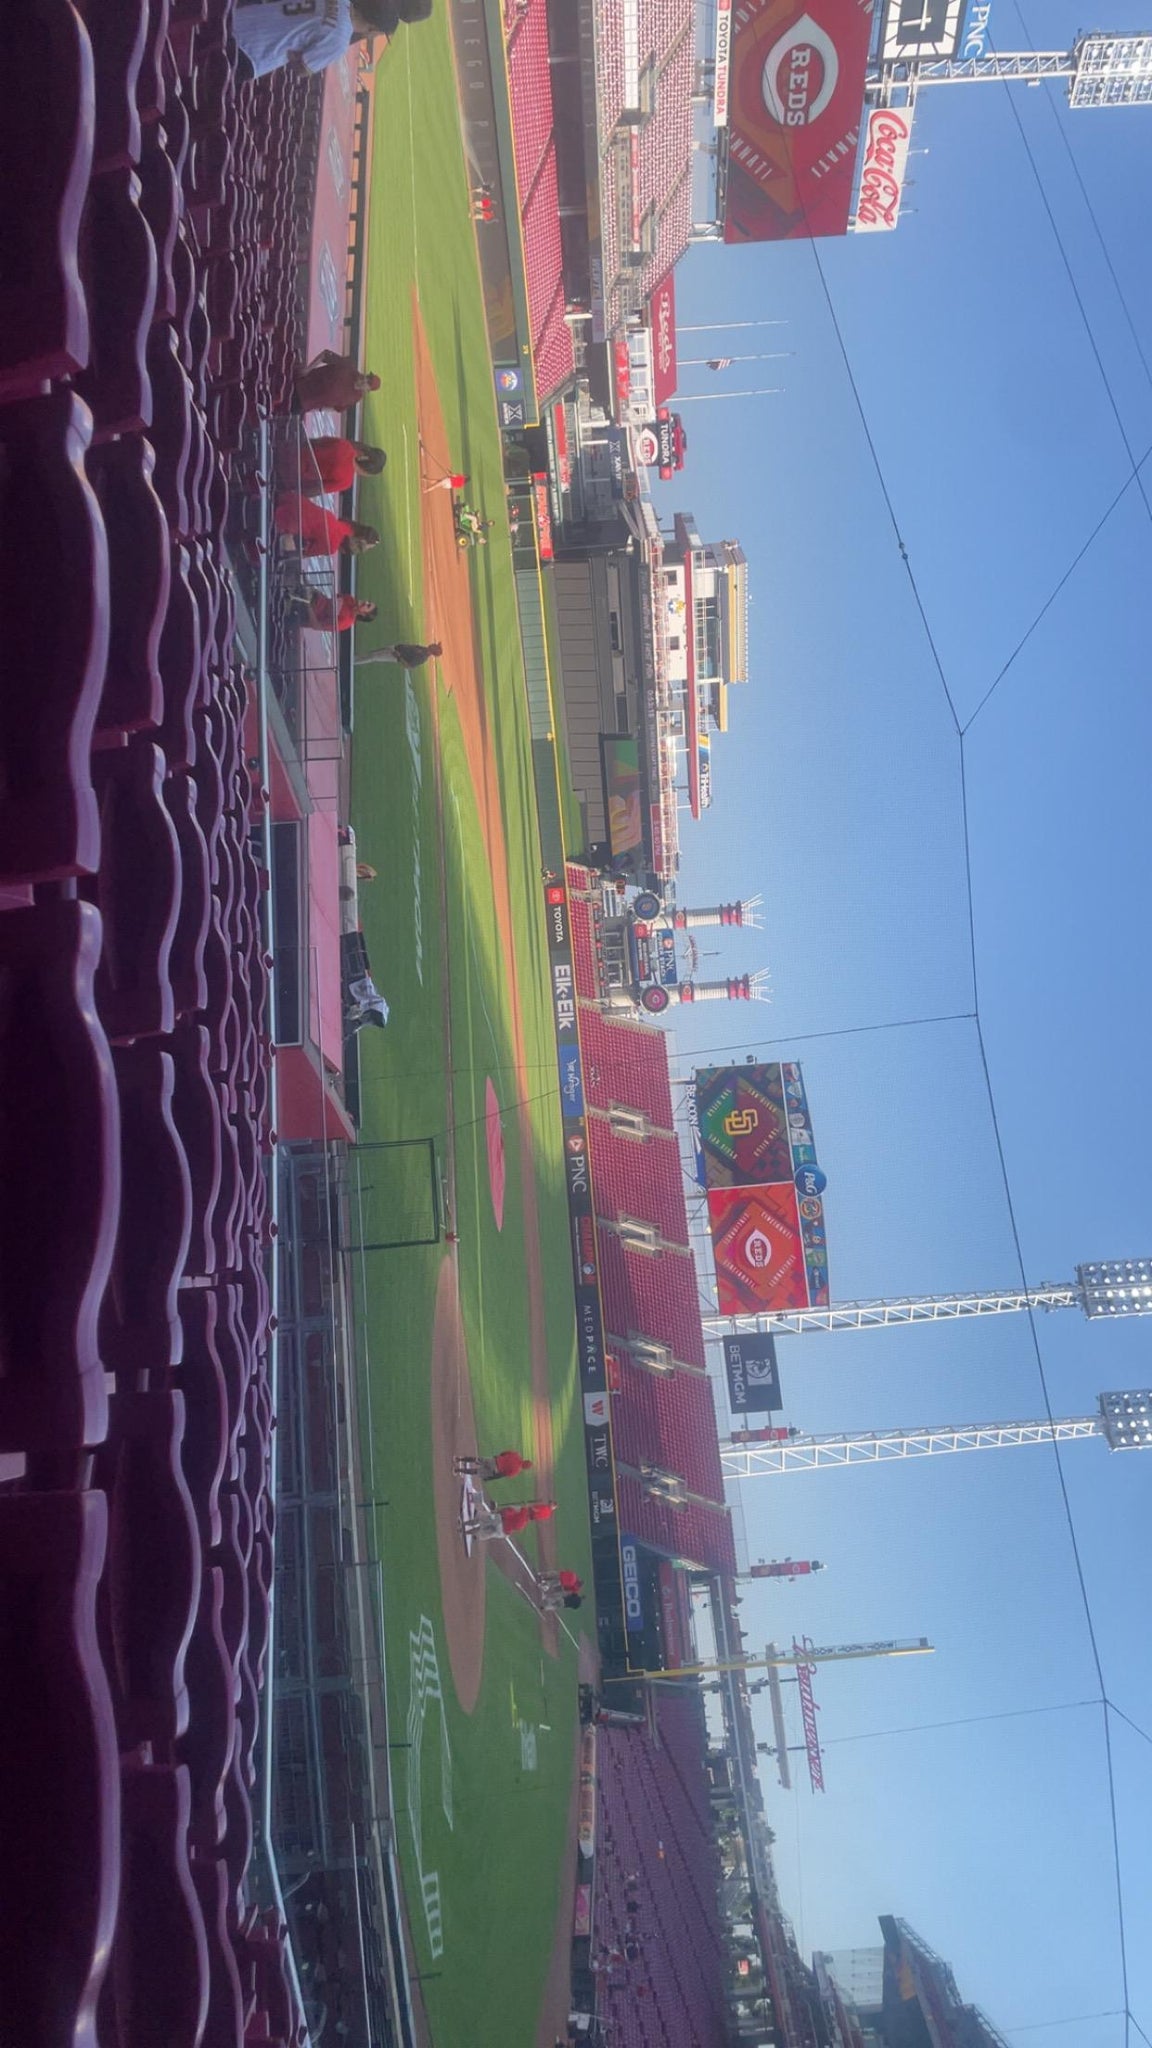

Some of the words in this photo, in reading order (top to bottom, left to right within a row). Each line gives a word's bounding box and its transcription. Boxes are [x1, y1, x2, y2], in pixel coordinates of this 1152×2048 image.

[718, 15, 729, 63] TOYOTA
[964, 2, 991, 57] PNC
[716, 65, 727, 115] TUNDRA
[786, 48, 811, 126] REDS
[857, 110, 908, 228] Coca-Cola
[660, 423, 670, 464] TUNDRA
[553, 906, 564, 942] TOYOTA
[663, 950, 675, 972] PNC
[685, 1084, 698, 1125] BEACON
[570, 1154, 587, 1193] PNC
[804, 1172, 818, 1194] P&G
[753, 1240, 765, 1268] REDS
[583, 1305, 596, 1374] MEDPACE
[729, 1345, 747, 1404] BETMGM
[594, 1433, 609, 1468] TWC
[622, 1545, 641, 1618] GEICO
